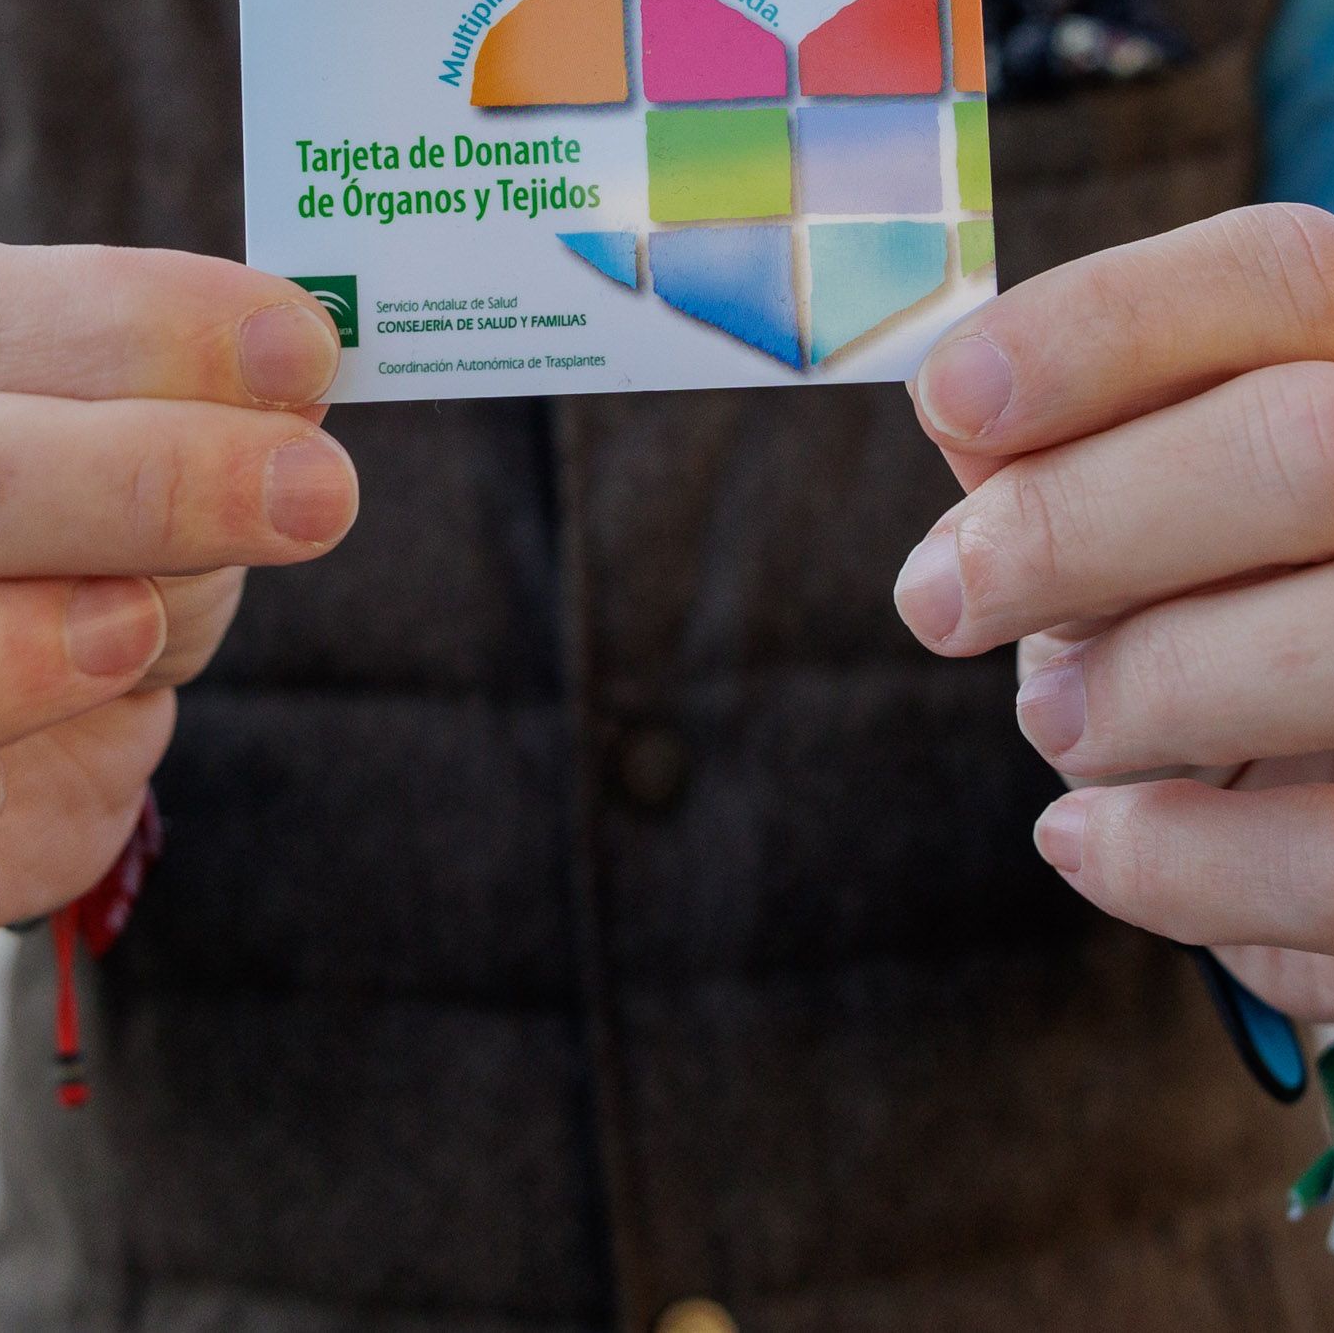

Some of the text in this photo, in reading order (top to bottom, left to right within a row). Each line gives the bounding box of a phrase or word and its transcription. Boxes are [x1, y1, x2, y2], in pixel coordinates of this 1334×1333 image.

[295, 135, 581, 180] Tarjeta de Donante
[298, 177, 601, 225] de Órganos y Tejidos
[376, 296, 518, 314] Servicio Andaluz de Salud
[377, 314, 587, 333] CONSEJERÍA DE SALUD Y FAMILIAS
[378, 354, 606, 375] Coordinación Autonómica de Trasplantes
